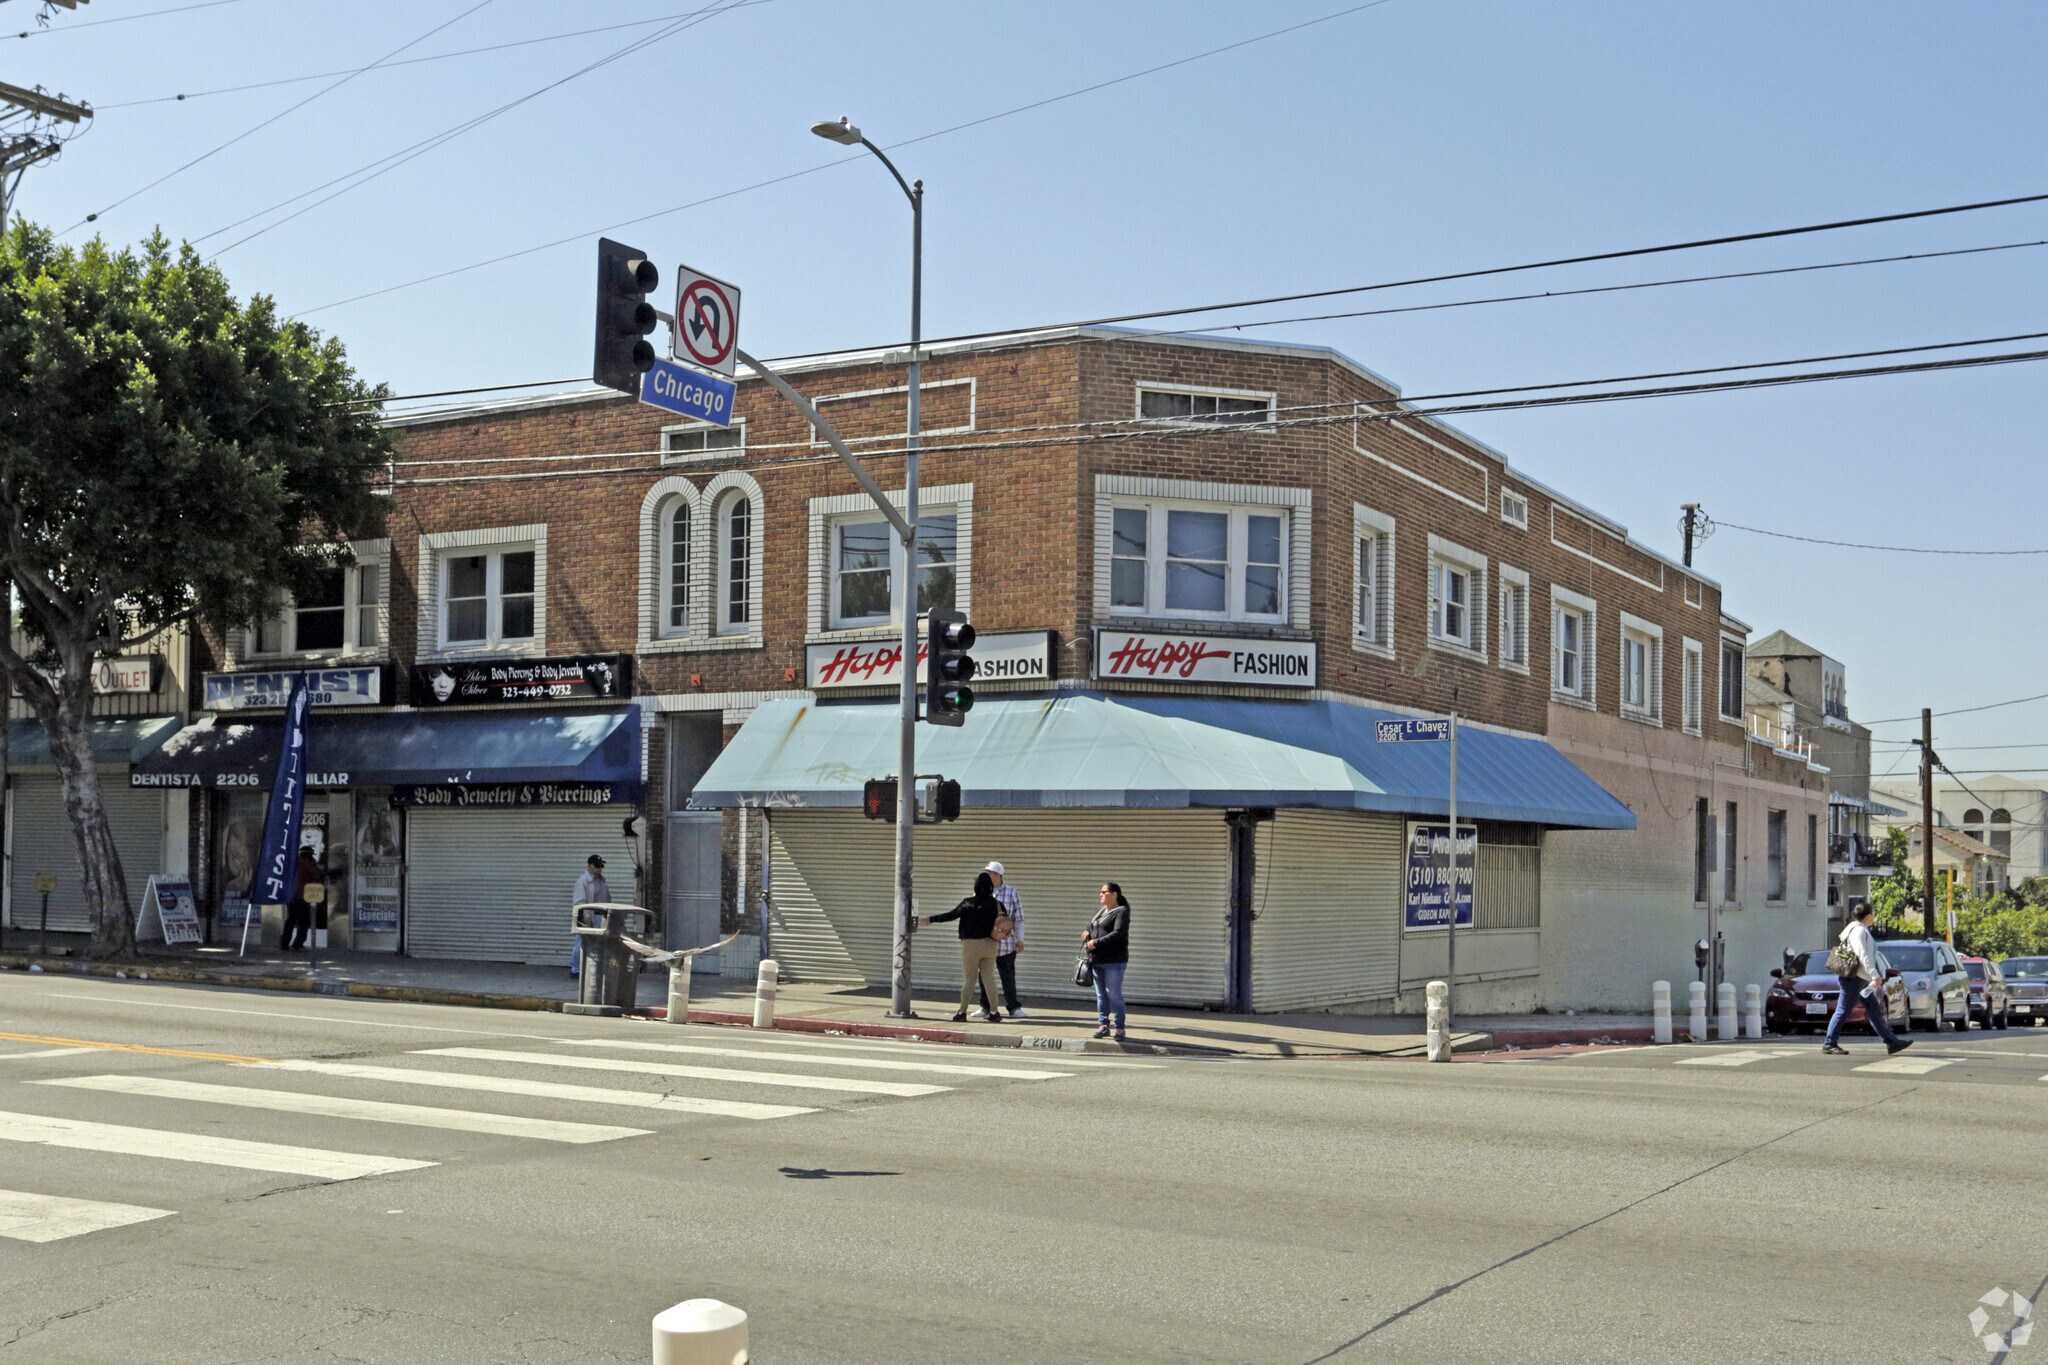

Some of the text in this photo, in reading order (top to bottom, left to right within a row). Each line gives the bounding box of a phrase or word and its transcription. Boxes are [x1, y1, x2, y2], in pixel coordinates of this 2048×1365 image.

[654, 369, 724, 416] Chicago
[1108, 637, 1308, 678] Happy FASHION
[491, 667, 508, 683] Body
[508, 665, 534, 682] Piercing
[535, 665, 541, 678] &
[541, 664, 558, 680] Body
[973, 657, 1043, 677] ASHION
[502, 684, 572, 698] 323-449-0732
[244, 693, 267, 706] 323
[309, 692, 332, 704] 680
[1378, 721, 1448, 734] Cesar E Chavez
[1379, 732, 1404, 741] 2200 E
[132, 772, 349, 786] DENTISTA 2206 ILIAR
[414, 784, 611, 806] Body Jewelry & Piercings
[302, 814, 326, 826] 2206
[1432, 832, 1472, 855] Avaable
[1409, 866, 1473, 888] (310) 8807900
[1408, 892, 1420, 905] Karl
[1032, 1037, 1062, 1050] 2200
